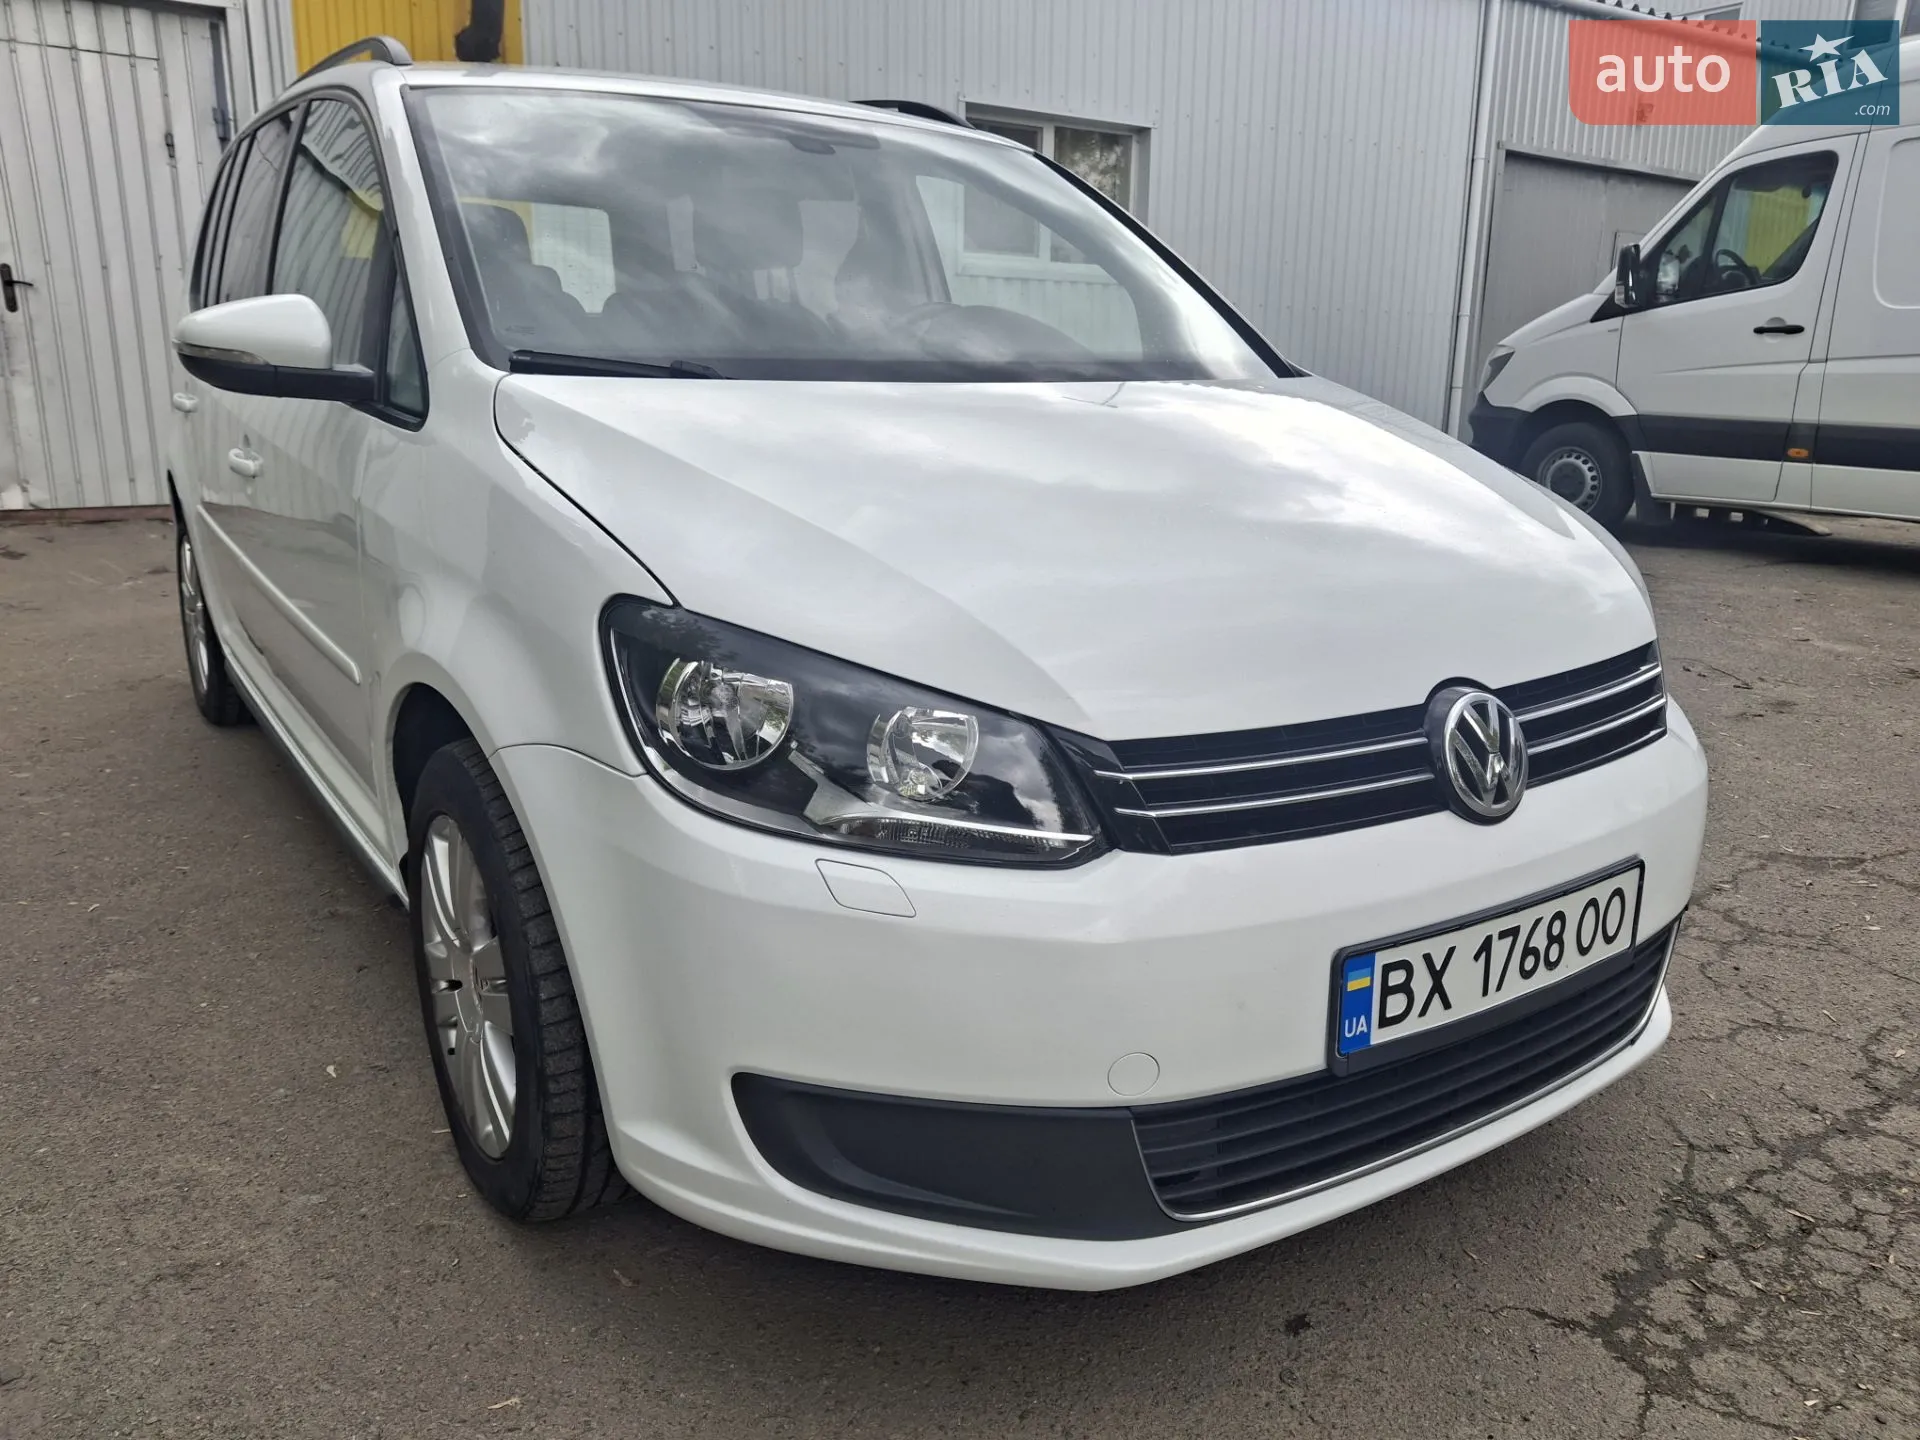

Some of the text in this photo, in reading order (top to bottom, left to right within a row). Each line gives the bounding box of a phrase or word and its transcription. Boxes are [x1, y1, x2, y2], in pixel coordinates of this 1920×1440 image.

[1377, 945, 1457, 1030] BX
[1473, 909, 1567, 998] 1768
[1344, 1014, 1368, 1039] UA
